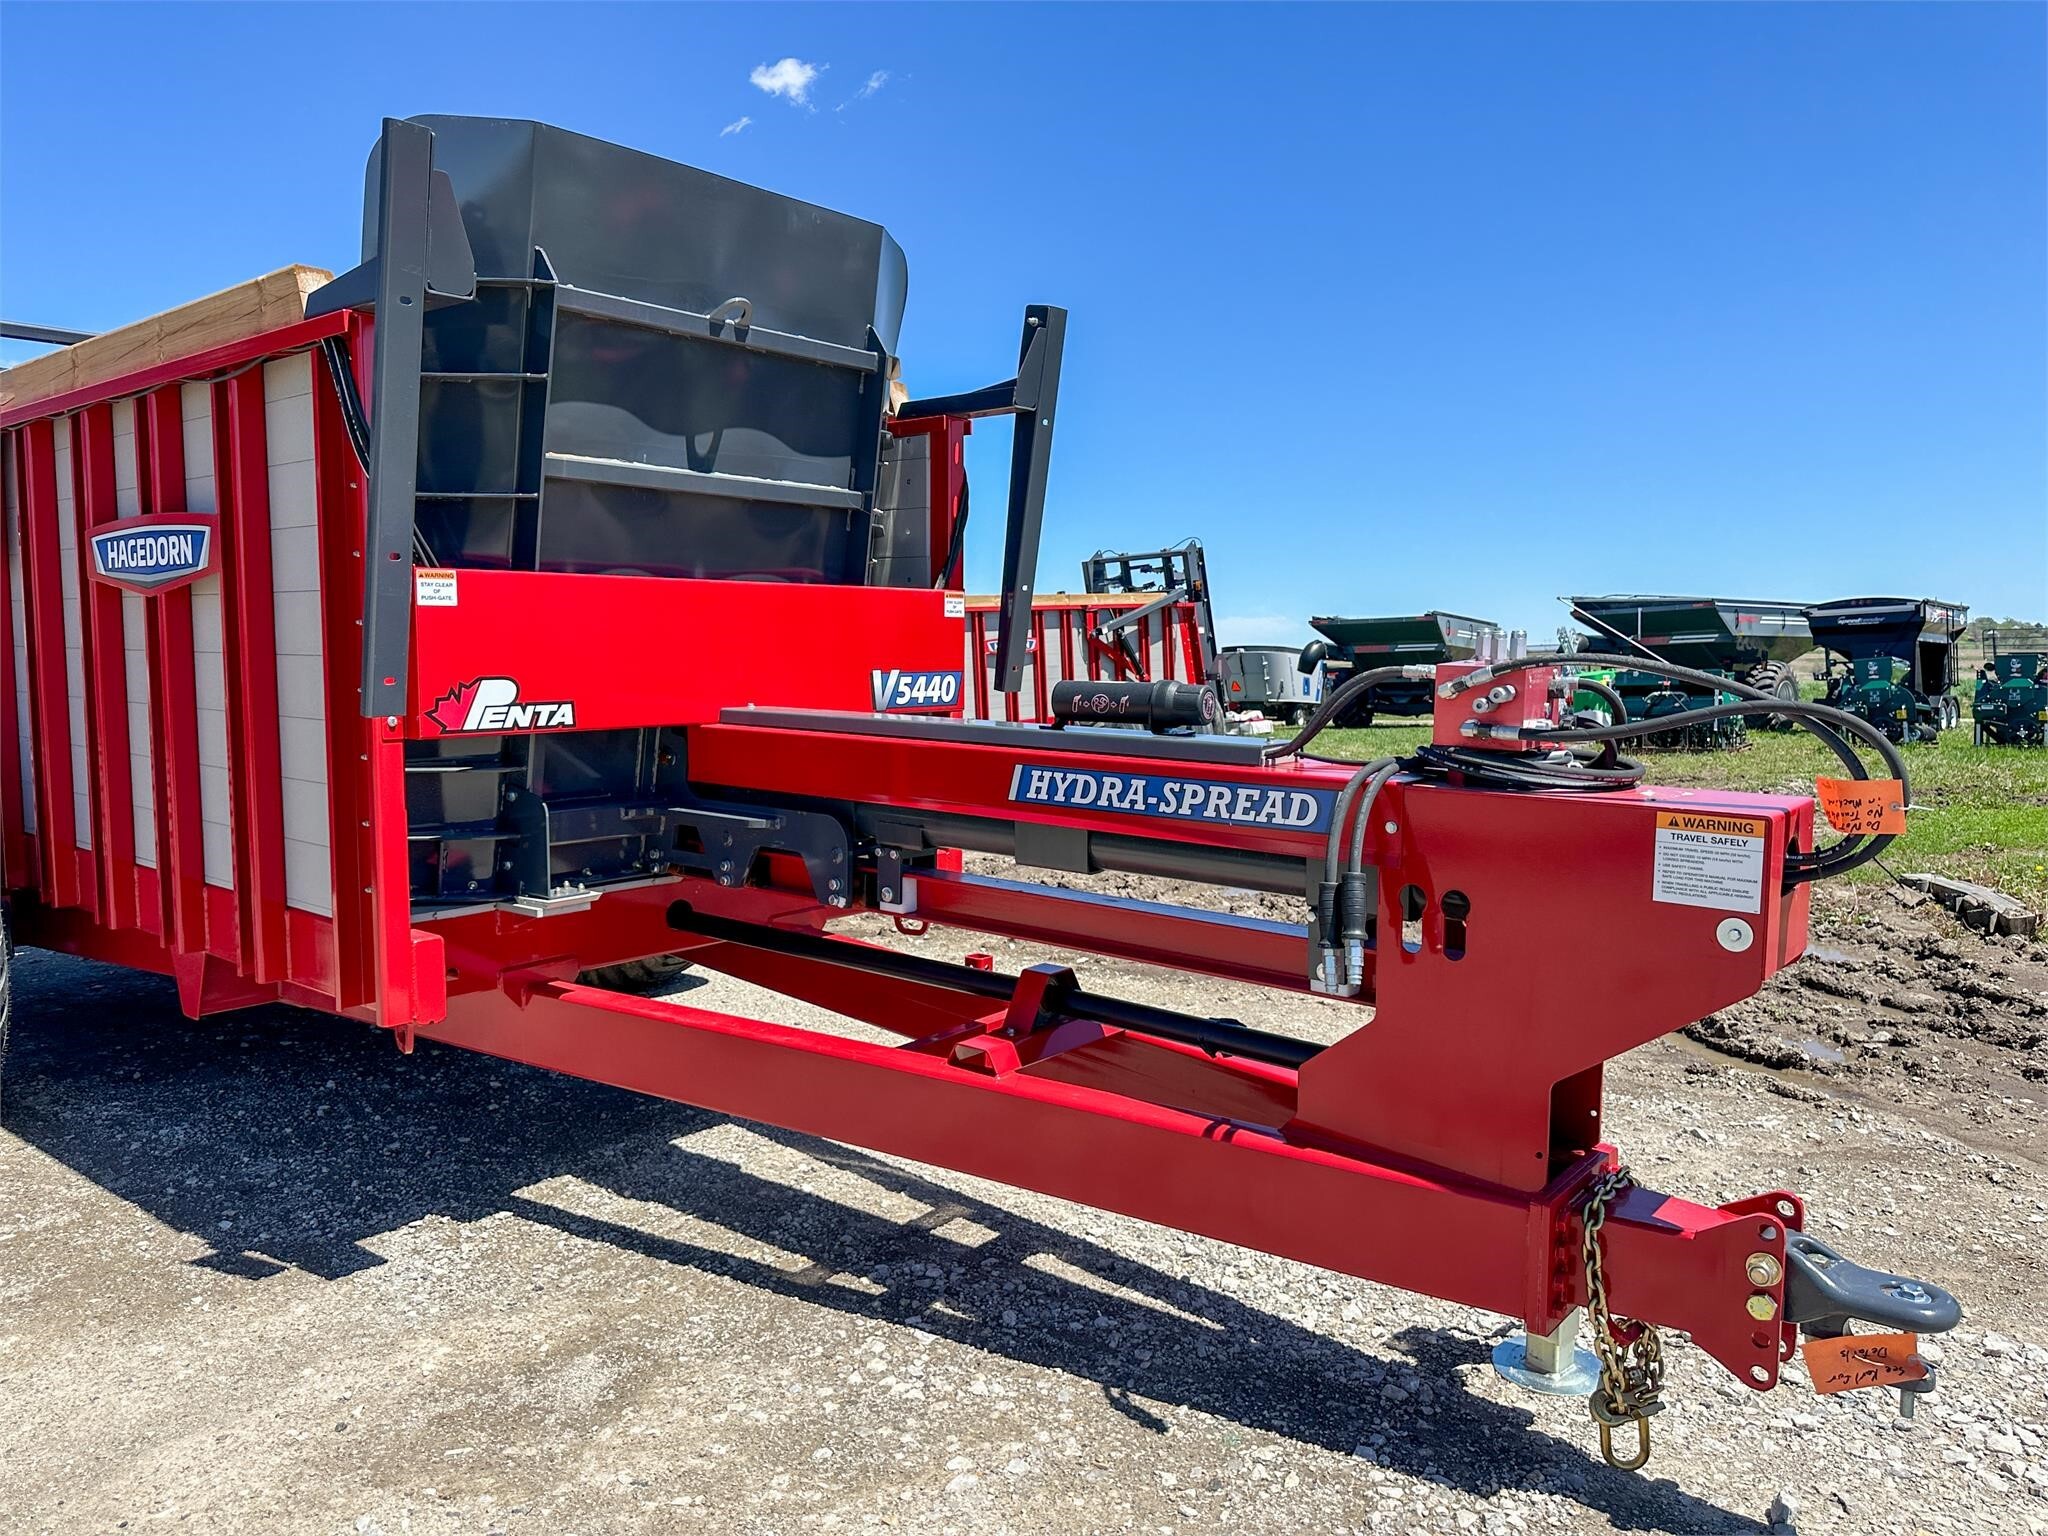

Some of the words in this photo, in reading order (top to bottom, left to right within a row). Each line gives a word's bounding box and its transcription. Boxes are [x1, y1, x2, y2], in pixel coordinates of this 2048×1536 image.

[107, 534, 193, 569] HAGEDORN
[462, 679, 574, 731] PENTA
[1026, 769, 1319, 828] HYDRA-SPREAD
[1682, 816, 1754, 834] WARNING
[1866, 820, 1880, 831] Do
[1670, 832, 1708, 844] TRAVEL
[1710, 836, 1749, 848] SAFELY
[1884, 1365, 1905, 1376] See
